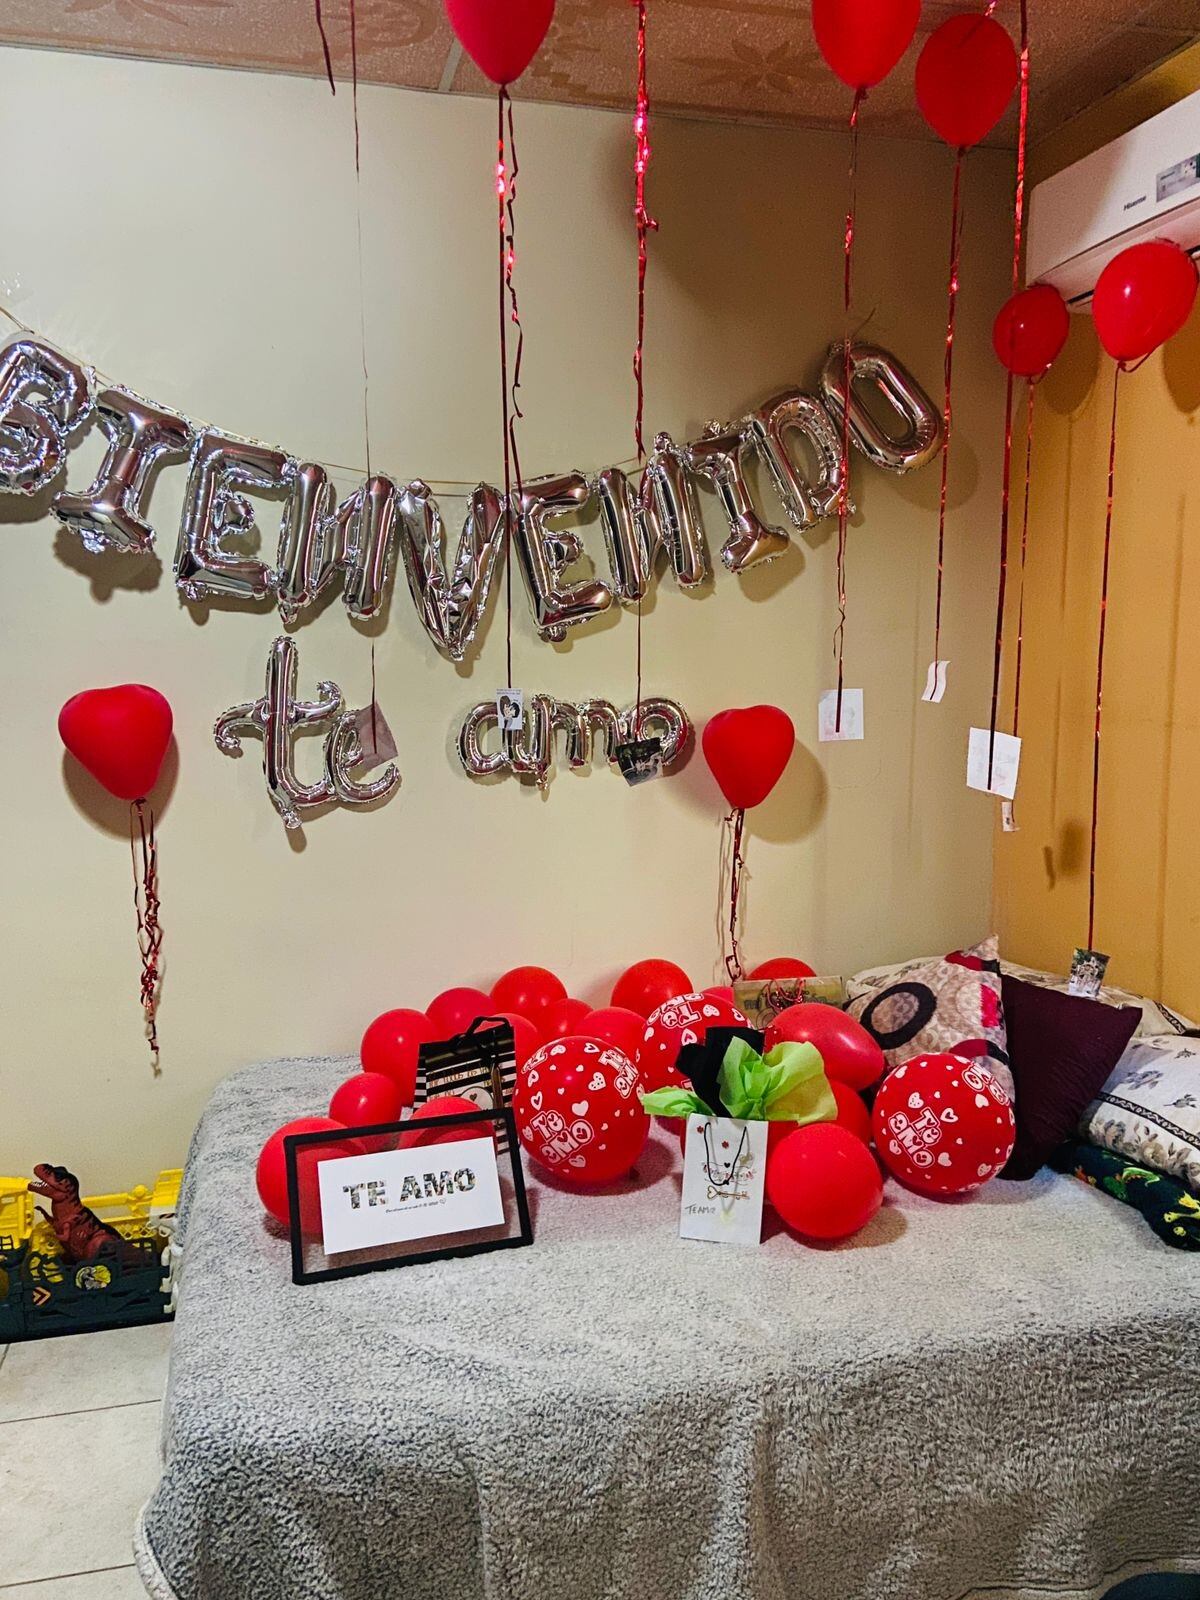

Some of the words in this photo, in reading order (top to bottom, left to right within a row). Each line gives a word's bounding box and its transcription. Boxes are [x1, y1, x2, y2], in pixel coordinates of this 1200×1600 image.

[213, 636, 401, 829] te
[456, 694, 695, 791] amo
[342, 1181, 387, 1210] TE
[400, 1167, 477, 1202] AMO
